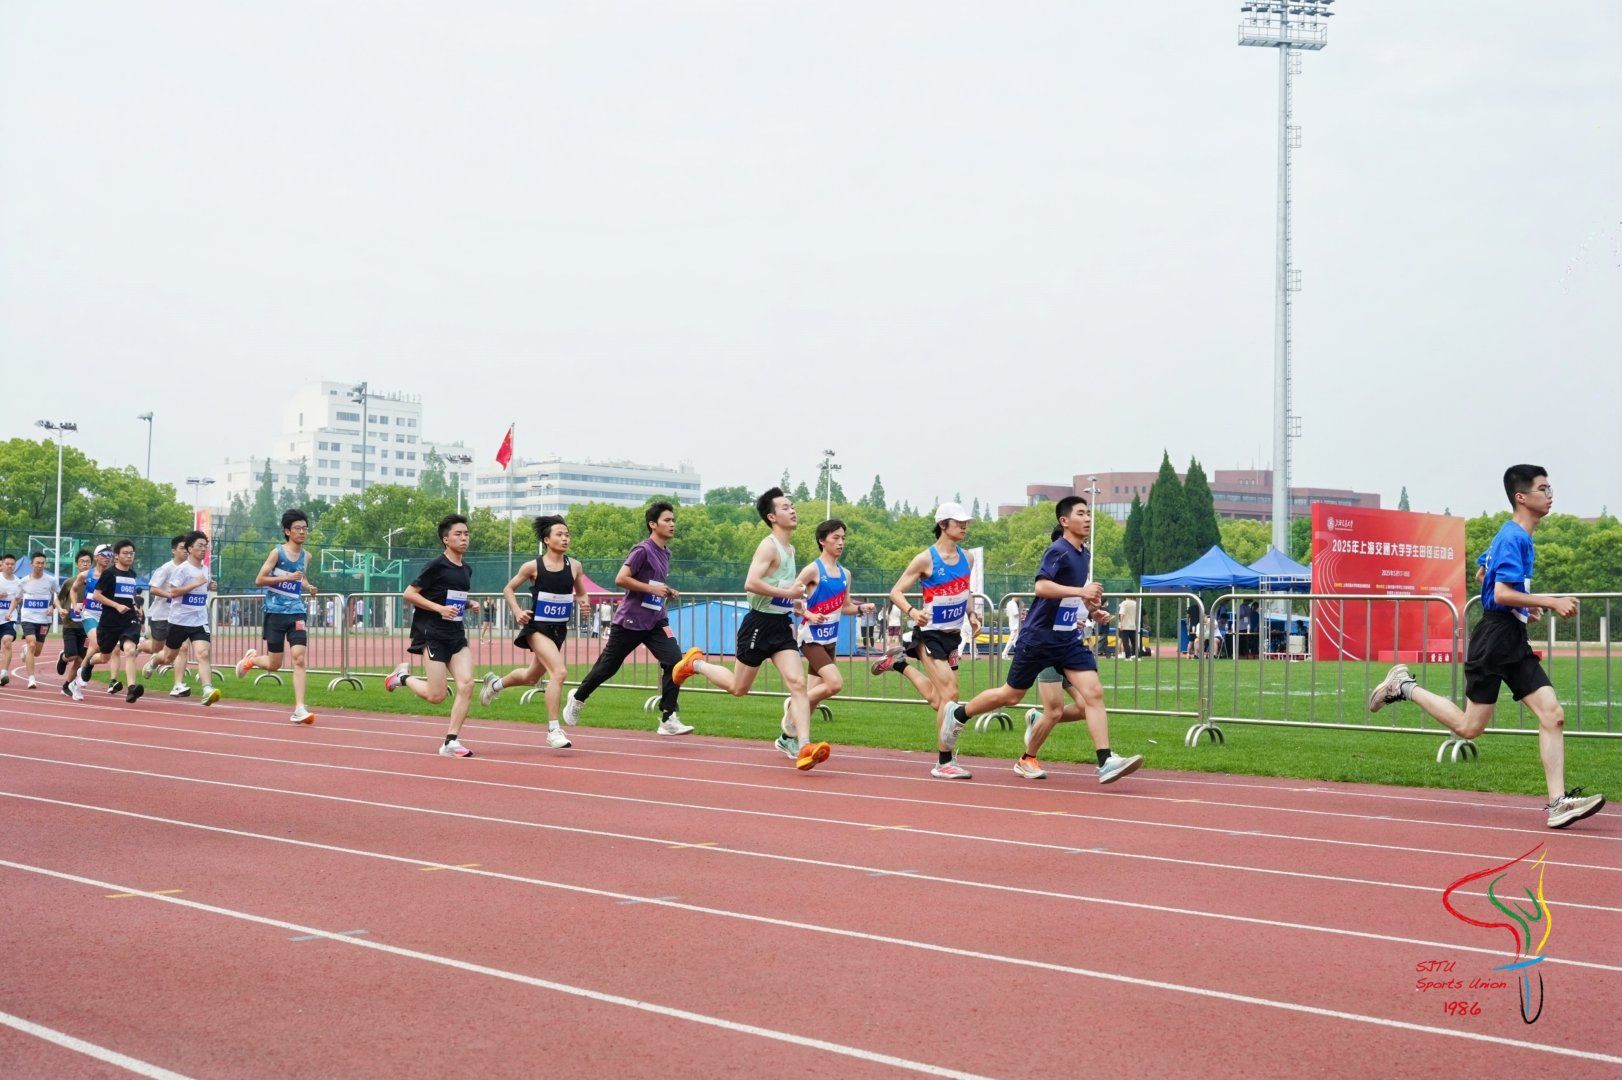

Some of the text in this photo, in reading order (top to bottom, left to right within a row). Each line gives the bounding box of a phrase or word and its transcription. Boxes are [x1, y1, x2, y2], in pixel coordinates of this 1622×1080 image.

[1332, 539, 1454, 560] 2025年上海交通大学学生田径运动会
[188, 596, 205, 604] 0512
[543, 605, 567, 615] 0518
[941, 606, 963, 619] 1703
